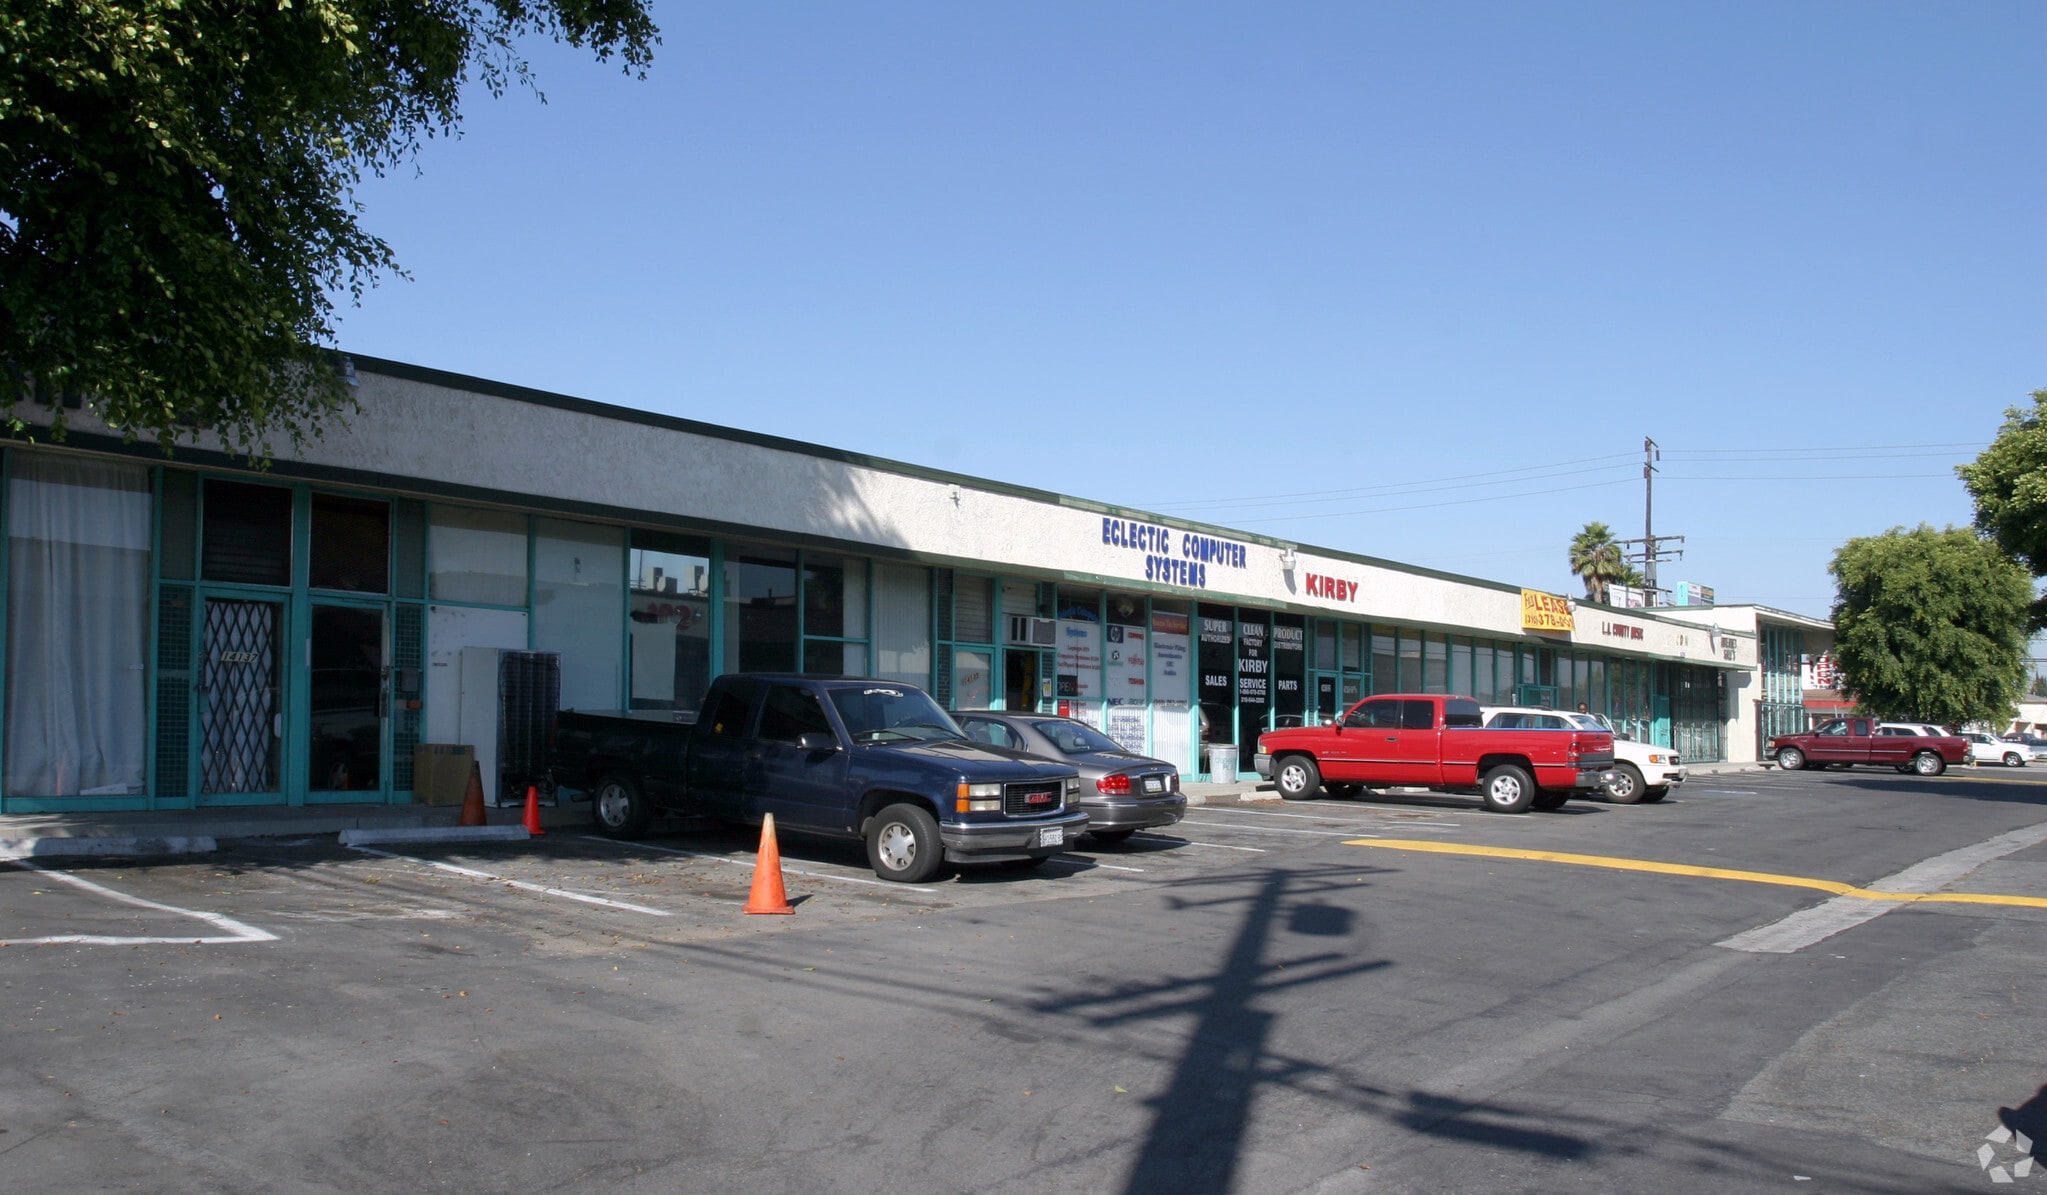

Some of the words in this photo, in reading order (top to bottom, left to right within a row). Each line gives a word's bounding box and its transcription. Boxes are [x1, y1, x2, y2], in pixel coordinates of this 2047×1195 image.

[1102, 517, 1169, 554] ECLECTIC
[1182, 533, 1247, 569] COMPUTER
[1145, 555, 1206, 588] SYSTEMS
[1305, 572, 1359, 602] KIRBY
[1204, 619, 1227, 633] SUPER
[1243, 624, 1264, 637] CLEAN
[1201, 633, 1231, 644] AUTHORIZED
[1274, 627, 1303, 641] PRODUCT
[1243, 638, 1263, 647] FACTORY
[224, 652, 257, 661] 14137
[1248, 649, 1258, 657] FOR
[1238, 658, 1268, 673] KIRBY
[1205, 675, 1228, 686] SALES
[1239, 678, 1267, 688] SERVICE
[1278, 680, 1298, 690] PARTS
